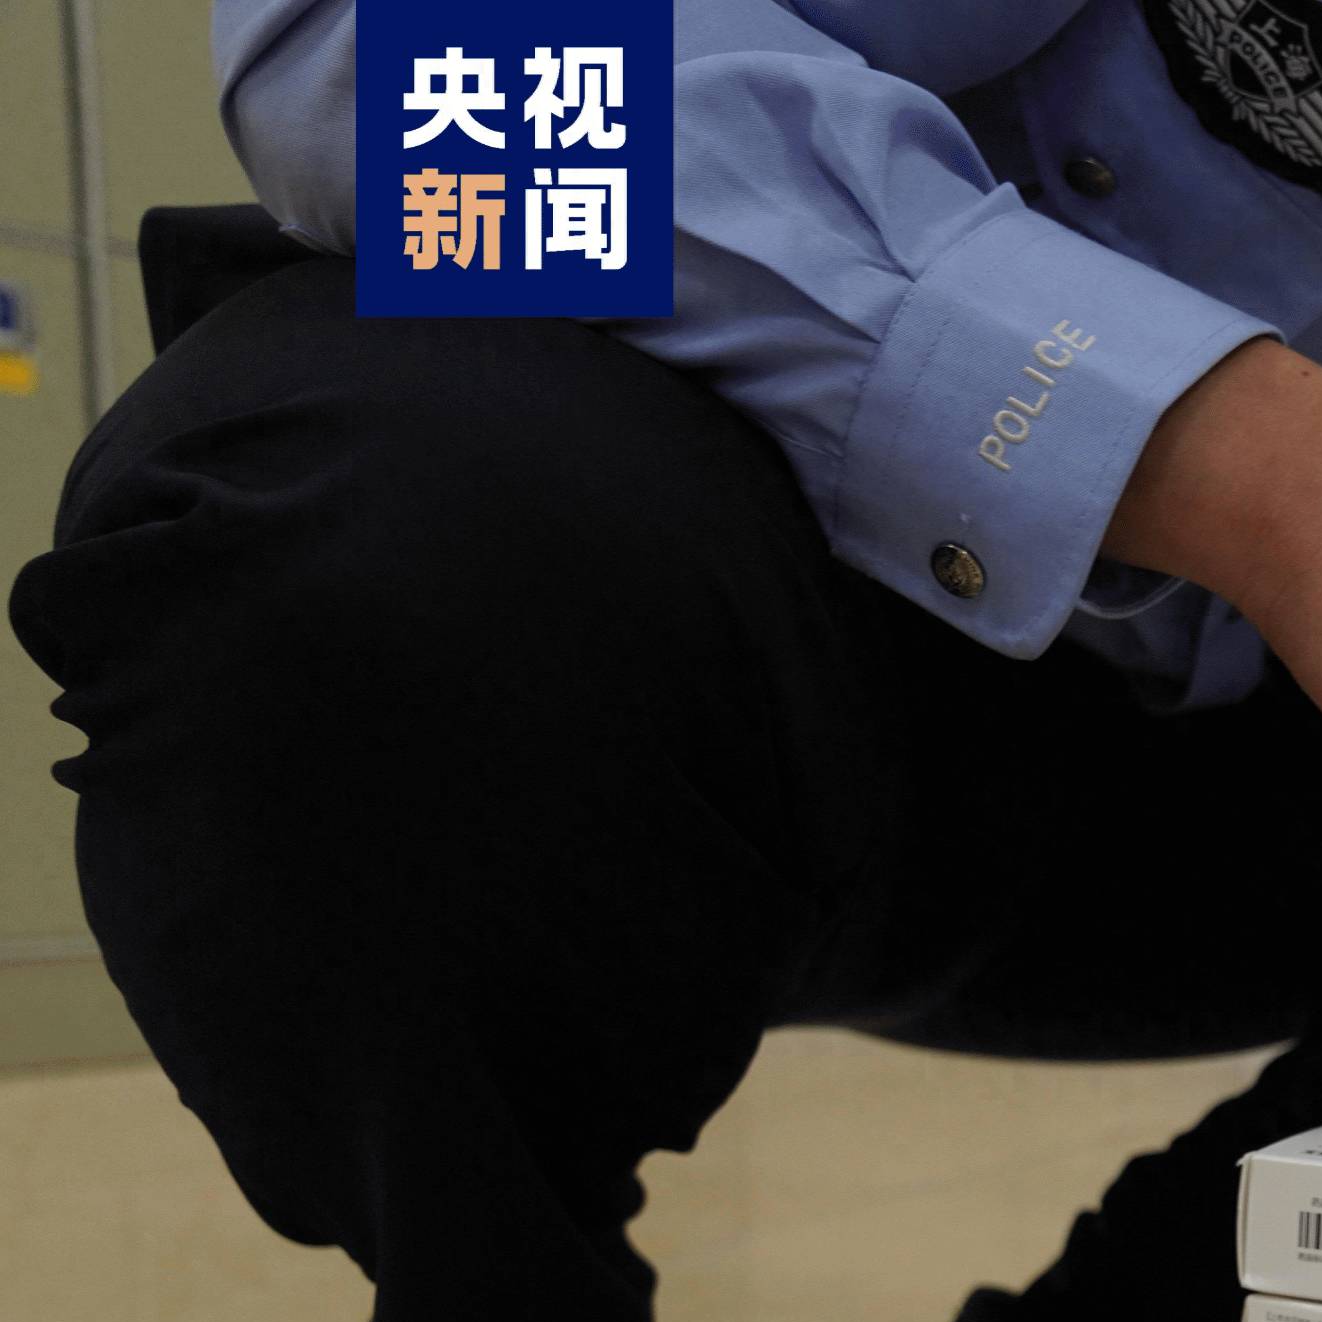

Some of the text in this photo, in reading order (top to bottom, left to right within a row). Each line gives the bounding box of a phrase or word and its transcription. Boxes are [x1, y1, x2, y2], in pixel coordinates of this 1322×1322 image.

[1228, 30, 1292, 99] POLICE
[1250, 18, 1313, 81] 上海
[977, 317, 1097, 474] POLICE
